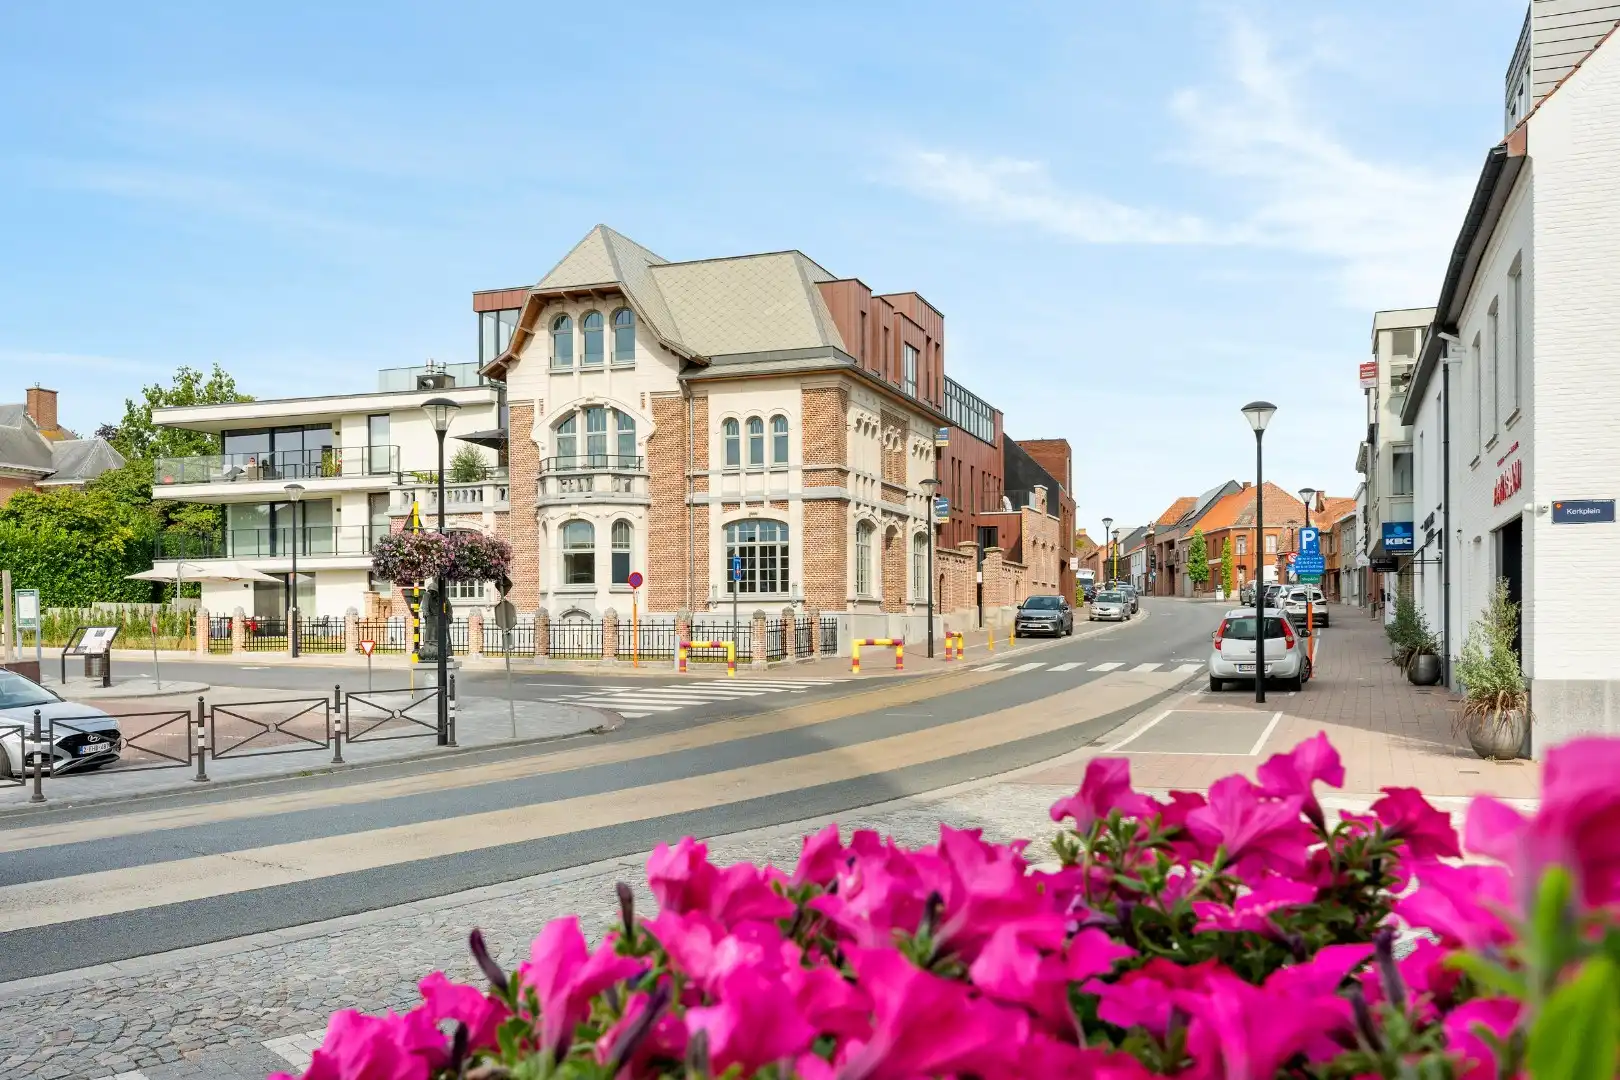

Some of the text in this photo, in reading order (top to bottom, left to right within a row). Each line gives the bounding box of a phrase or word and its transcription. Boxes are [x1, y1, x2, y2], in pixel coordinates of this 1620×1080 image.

[1566, 507, 1601, 516] Kerkplein
[1302, 530, 1316, 549] P
[1385, 537, 1412, 545] KBC
